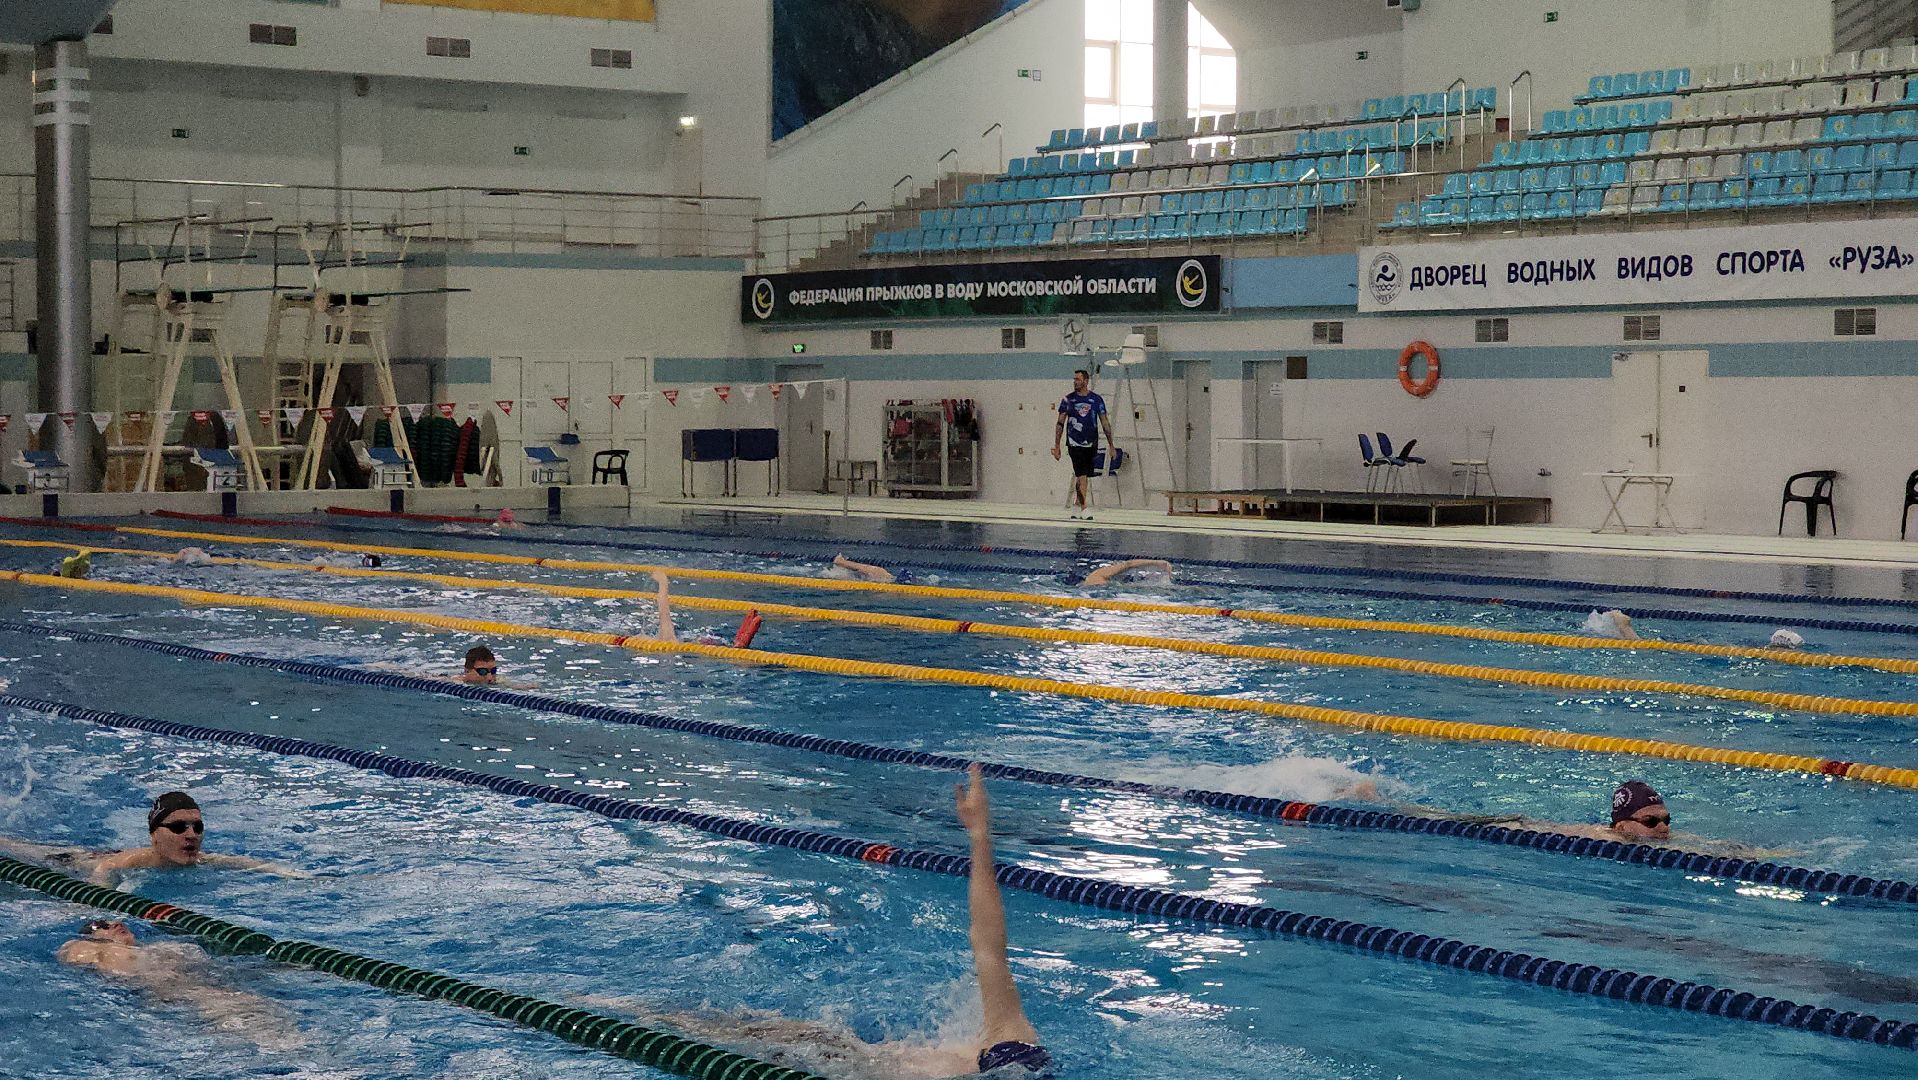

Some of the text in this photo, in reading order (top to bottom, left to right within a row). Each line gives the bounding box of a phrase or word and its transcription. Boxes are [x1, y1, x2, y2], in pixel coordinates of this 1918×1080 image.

[1410, 263, 1487, 291] ДВОРЕЦ
[1507, 258, 1596, 286] ВОДНЫХ
[1617, 254, 1693, 281] ВИДОВ
[1716, 249, 1805, 276] СПОРТА
[1829, 245, 1914, 274] «РУЗА»
[789, 275, 1157, 306] ФЕДЕРАЦИЯ ПРЫЖКОВ В ВОДУ МОСКОВСКОЙ ОБЛАСТИ
